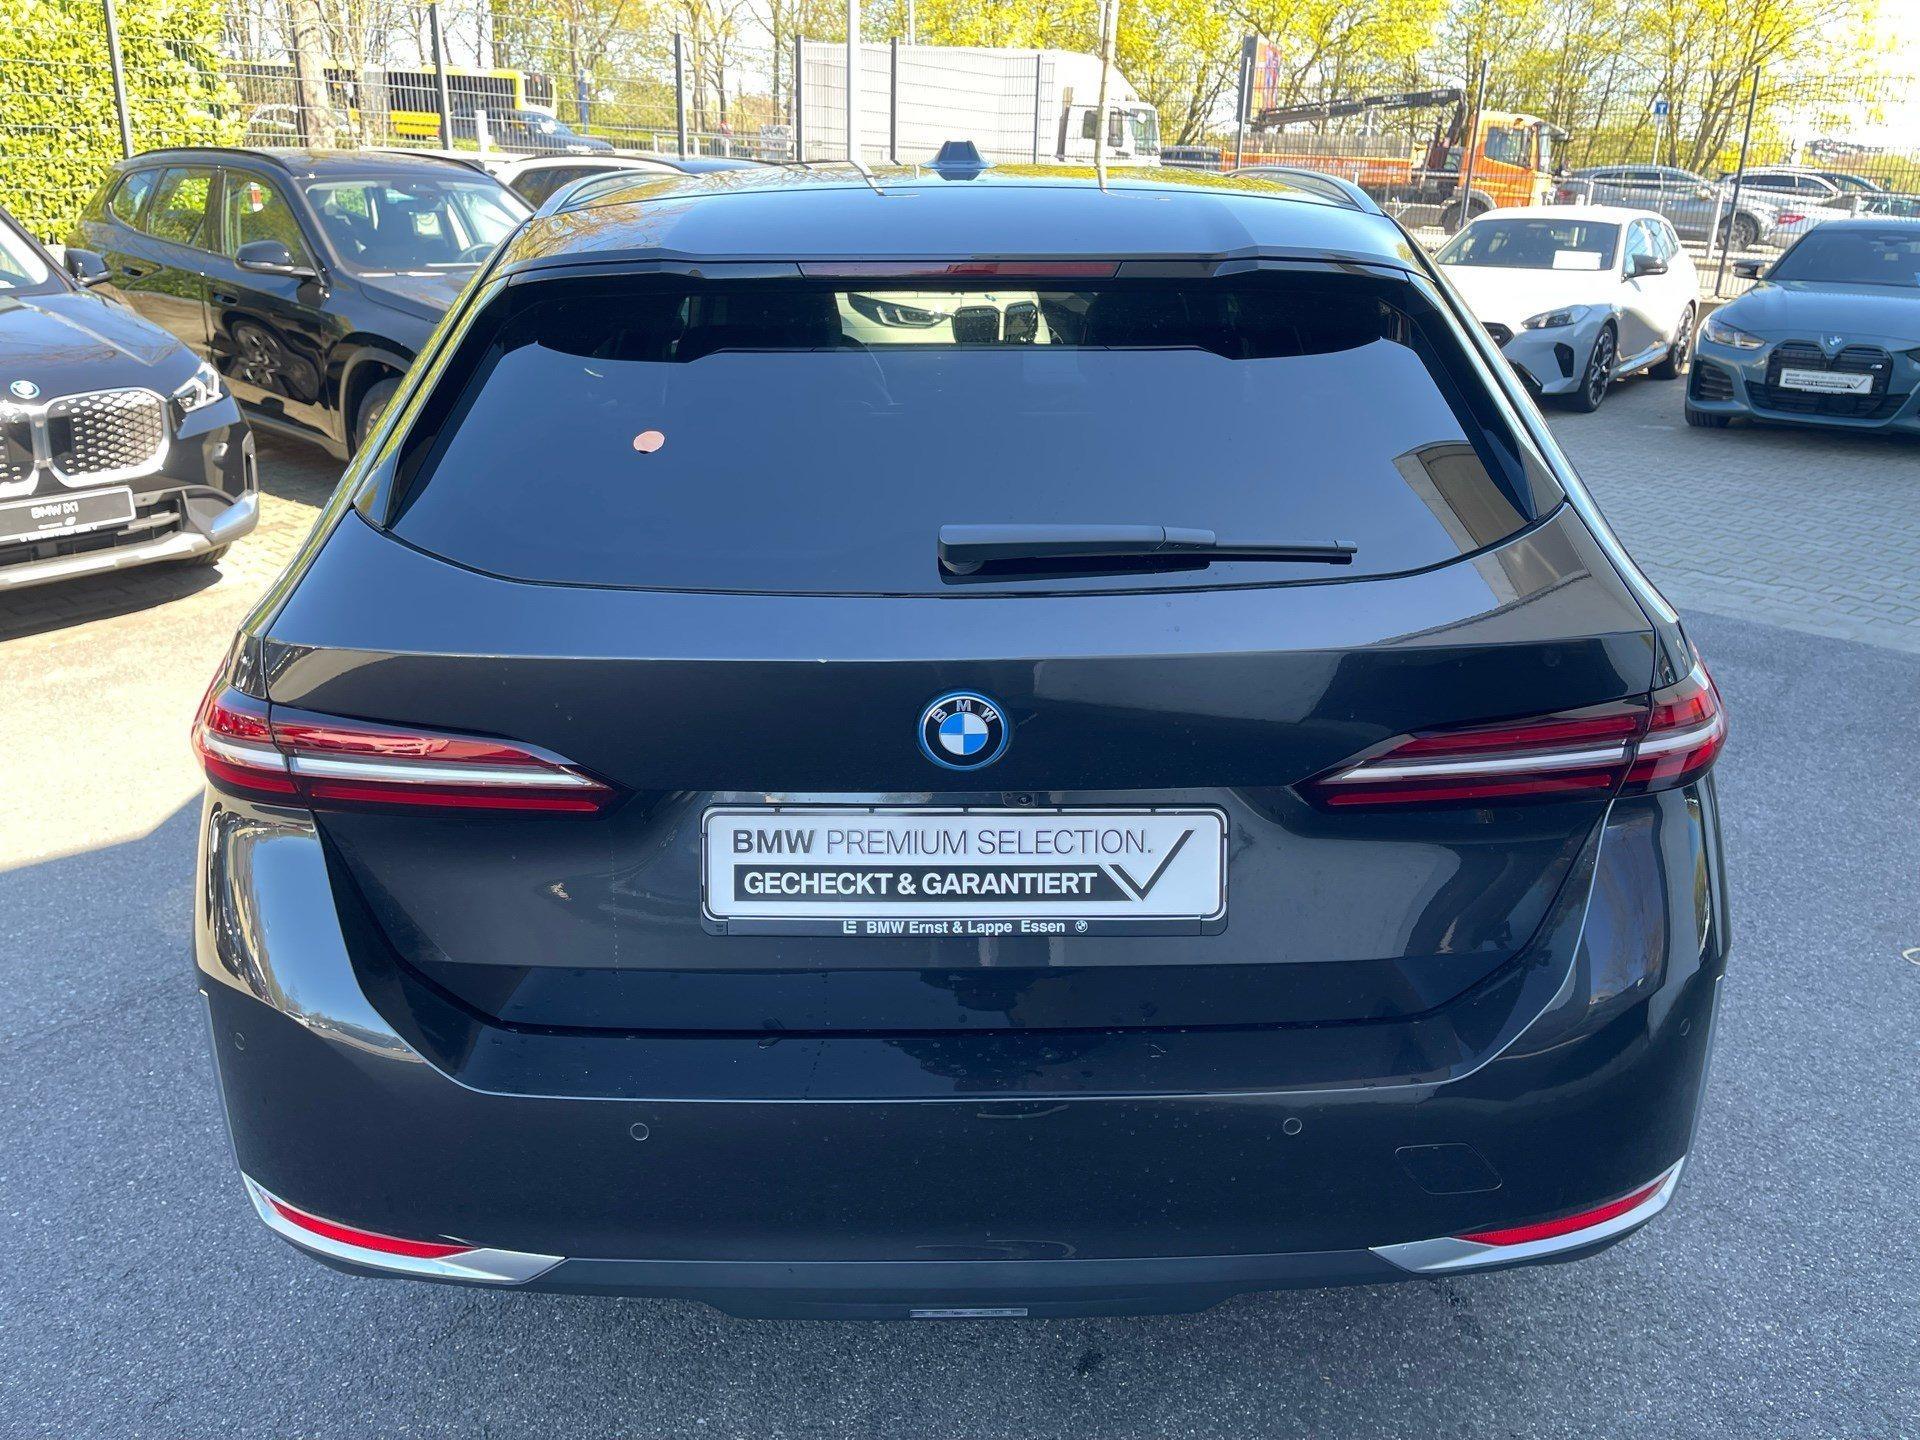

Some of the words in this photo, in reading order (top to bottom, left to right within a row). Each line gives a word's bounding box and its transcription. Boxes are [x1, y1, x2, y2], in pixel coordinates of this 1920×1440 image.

[931, 699, 998, 724] BMW
[732, 829, 815, 854] BMW
[827, 829, 967, 855] PREMIUM
[743, 872, 893, 895] GECHECKT
[897, 872, 917, 895] &
[922, 872, 1098, 895] GARANTIERT
[866, 921, 905, 934] BMW
[909, 920, 949, 934] Ernst
[952, 920, 963, 934] &
[967, 920, 1013, 936] Lappe
[1020, 920, 1066, 933] Essen
